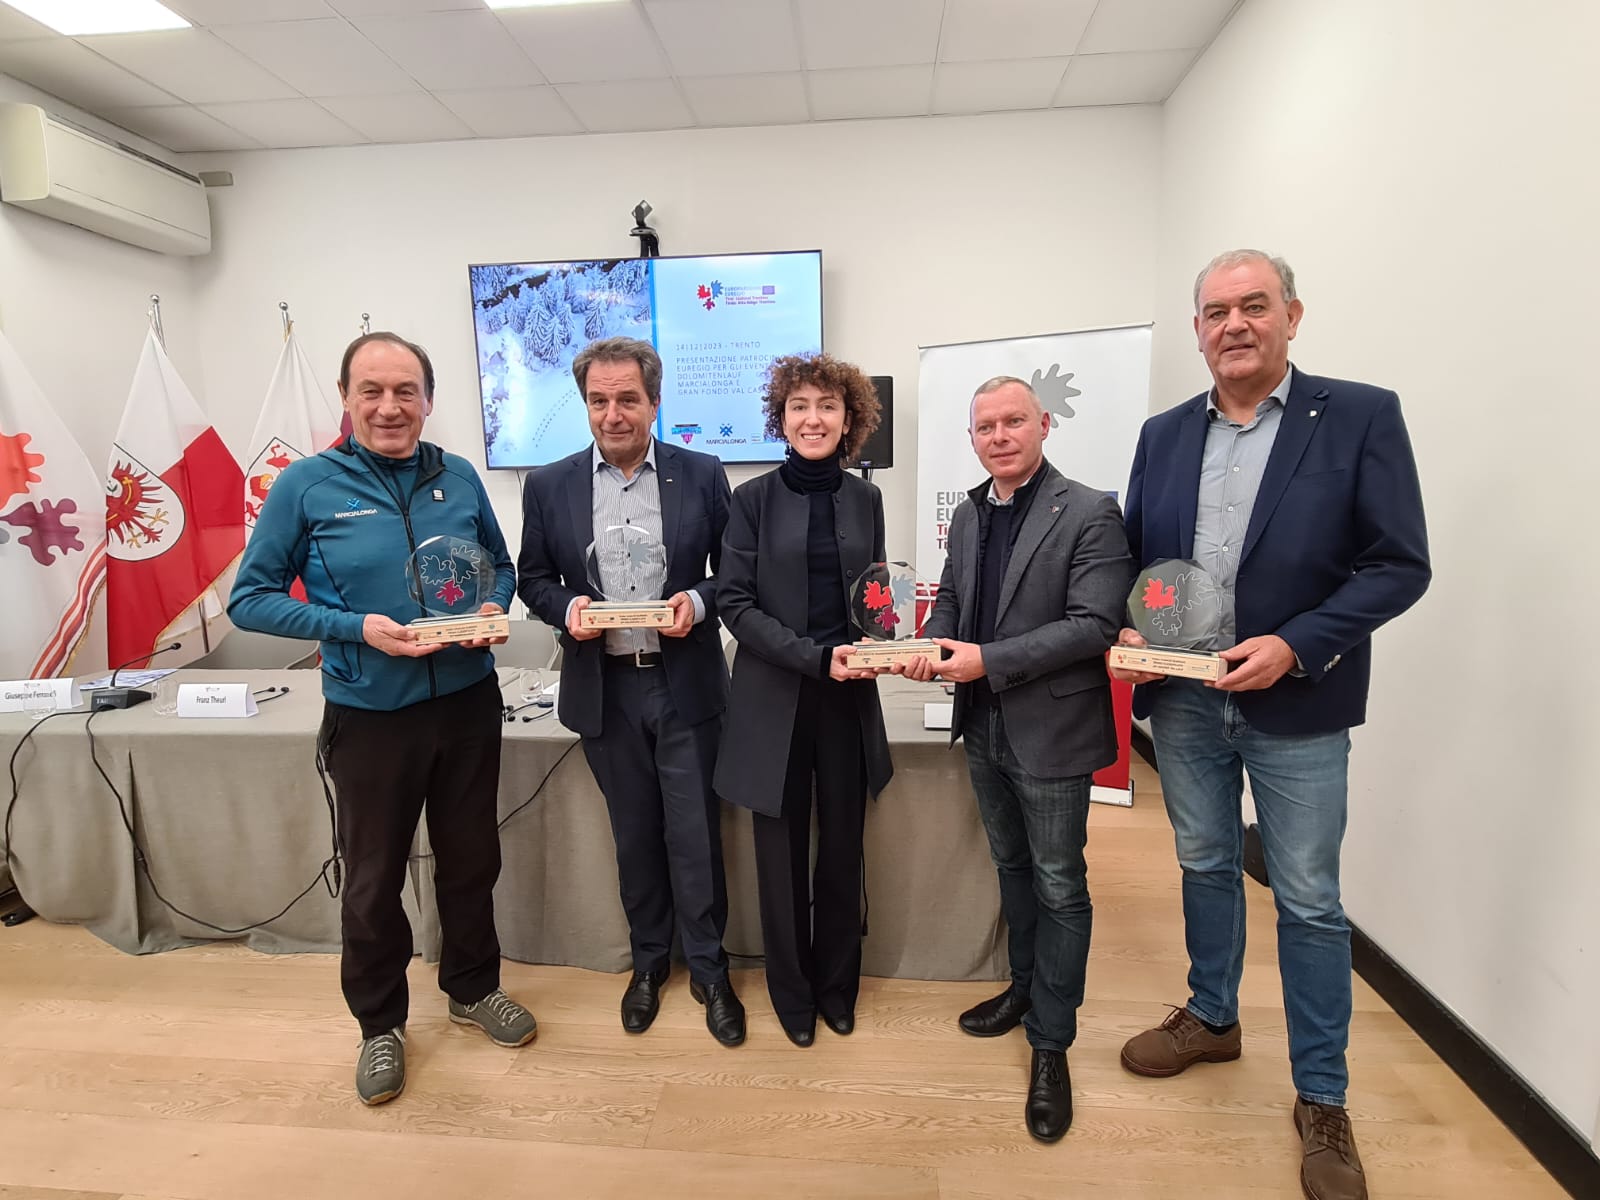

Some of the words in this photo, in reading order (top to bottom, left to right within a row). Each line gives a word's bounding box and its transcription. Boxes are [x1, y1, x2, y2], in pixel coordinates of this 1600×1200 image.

[730, 341, 760, 349] TRENTO
[676, 356, 737, 364] PRESENTAZIONE
[676, 364, 710, 373] EUREGIO
[712, 363, 727, 371] PER
[677, 371, 741, 380] DOLOMITENLAUF
[678, 379, 733, 388] MARCIALONGA
[678, 387, 699, 396] GRAN
[701, 387, 729, 395] FONDO
[731, 386, 745, 394] VAL
[936, 491, 967, 506] EUR
[334, 508, 378, 519] MARCIALONGA
[936, 508, 954, 521] EU
[936, 523, 948, 535] Ti
[5, 691, 32, 700] Giuseppe
[196, 695, 210, 704] Franz
[211, 695, 227, 704] Theurl
